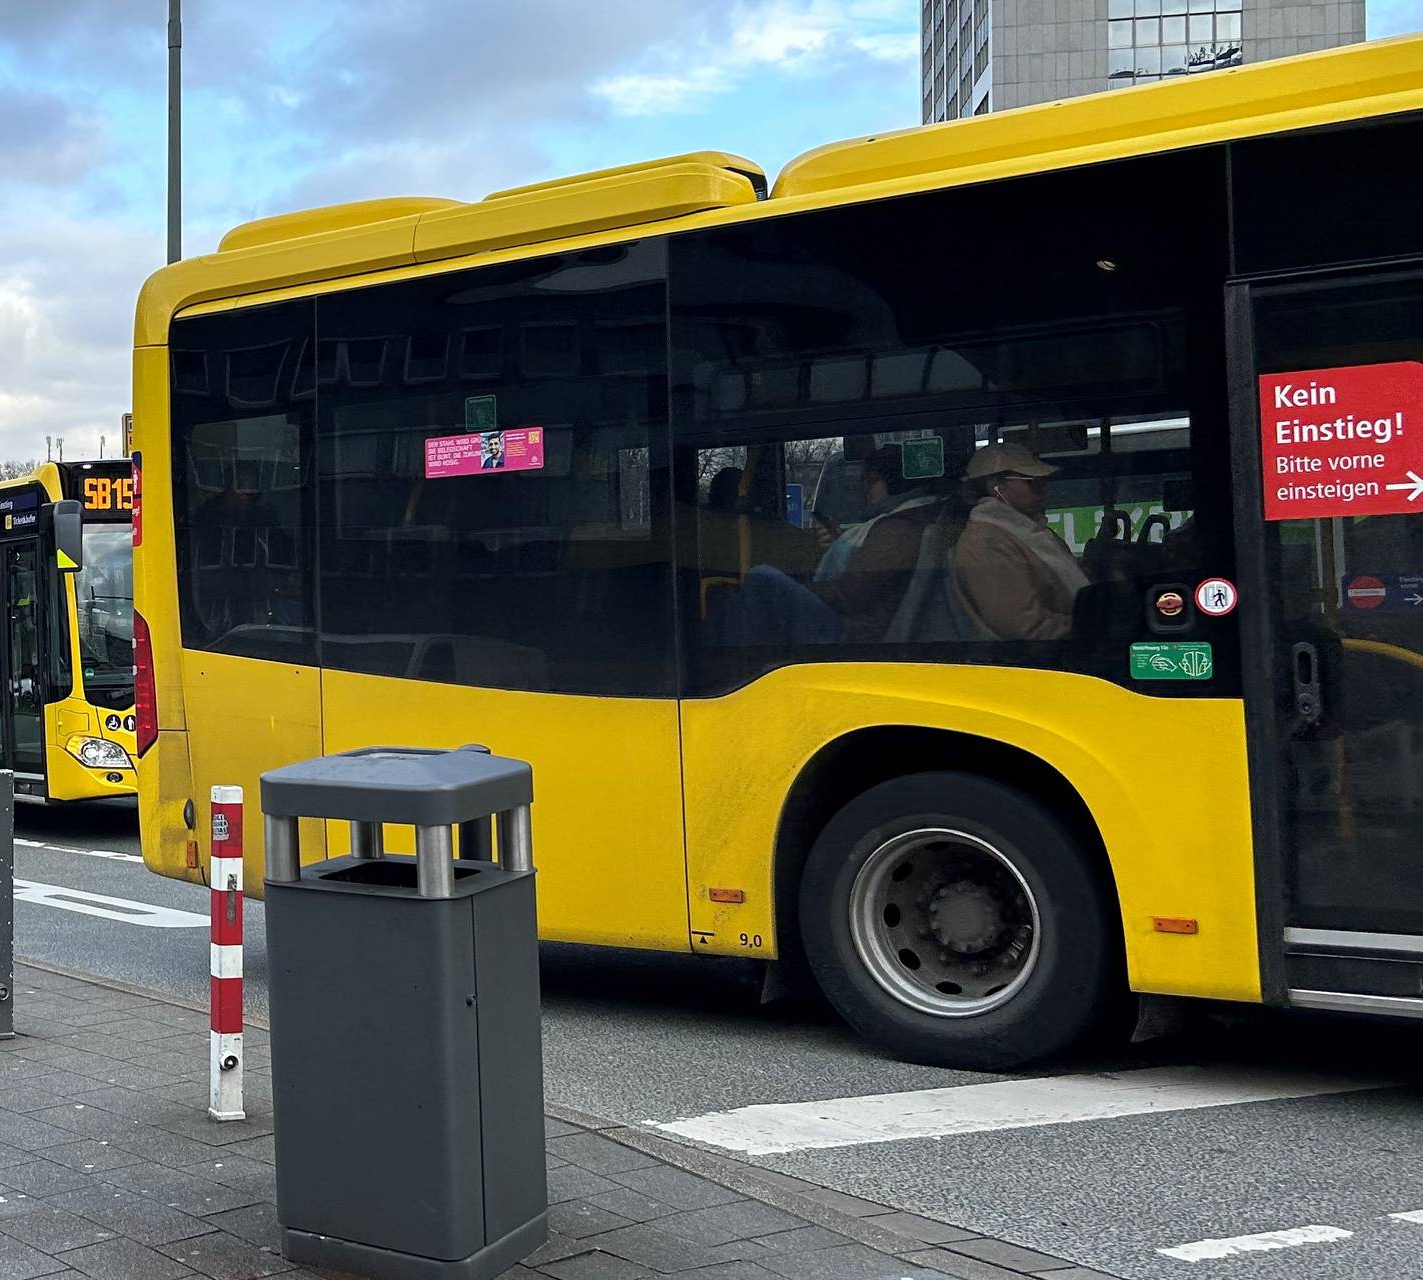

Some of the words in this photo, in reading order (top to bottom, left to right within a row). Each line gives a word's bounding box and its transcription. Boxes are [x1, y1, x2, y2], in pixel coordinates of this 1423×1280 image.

[1274, 381, 1336, 408] Kein
[1276, 412, 1403, 444] Einstieg!
[1276, 456, 1322, 474] Bitte
[1327, 453, 1385, 471] vorne
[84, 478, 133, 510] SB15
[1277, 480, 1379, 502] einsteigen
[739, 932, 763, 949] 9,0
